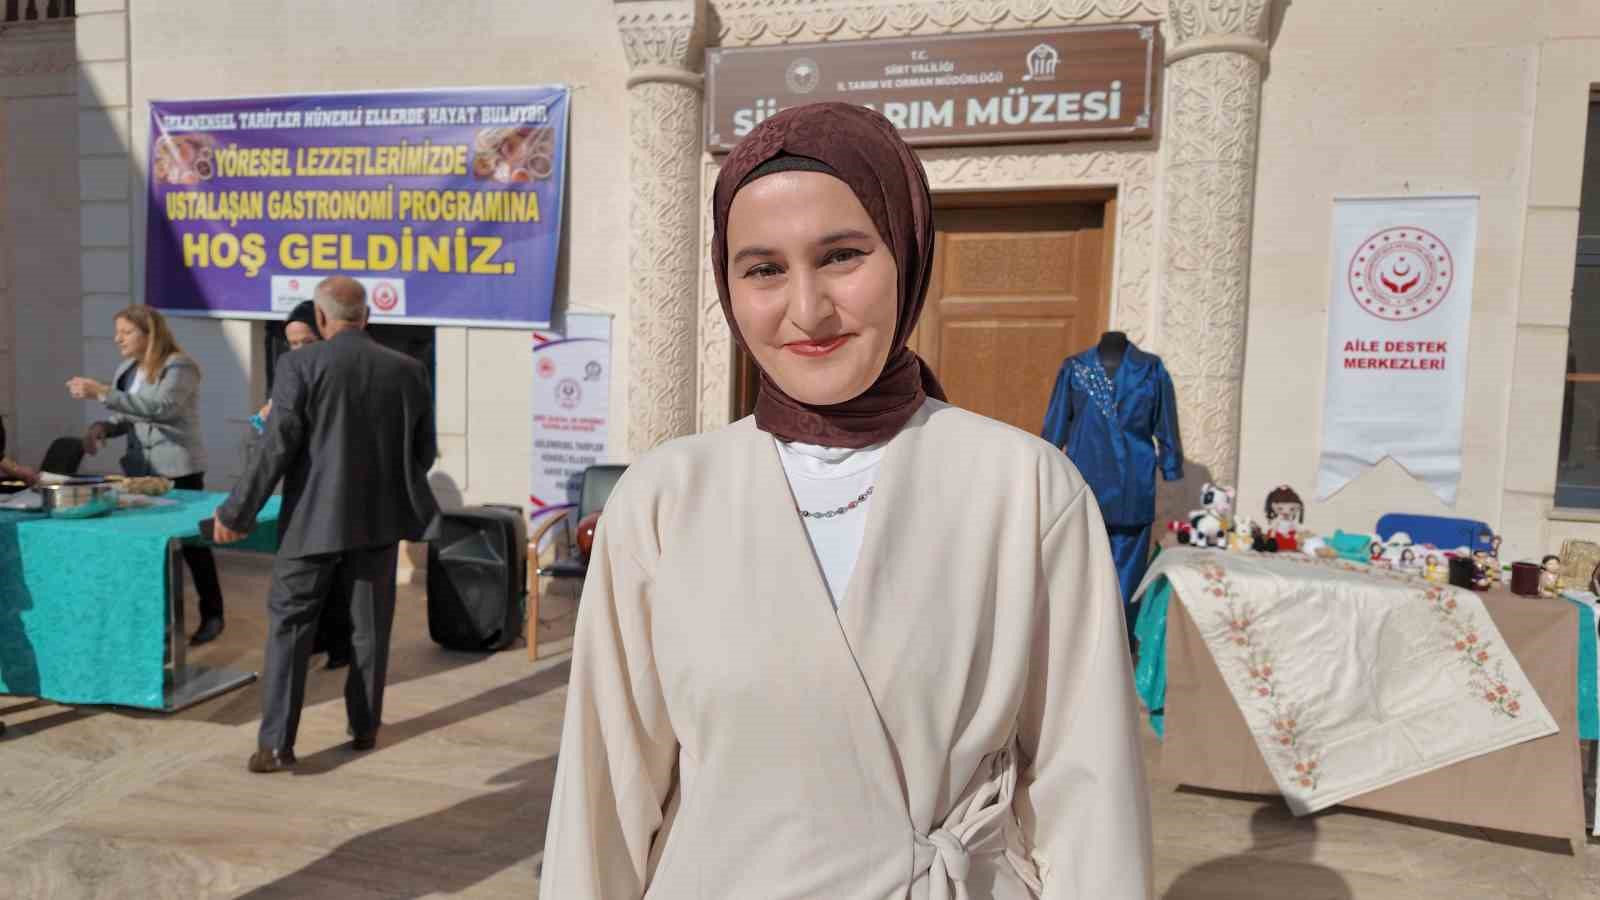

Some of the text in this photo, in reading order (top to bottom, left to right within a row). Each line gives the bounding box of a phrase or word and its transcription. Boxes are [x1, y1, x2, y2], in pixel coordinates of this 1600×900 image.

[881, 78, 894, 89] VE
[429, 106, 478, 124] HAYAT
[966, 80, 1122, 127] MÜZESİ
[214, 138, 468, 177] YÖRESEL LEZZETLERİMİZDE
[165, 183, 541, 227] USTALAŞAN GASTRONOMİ PROGRAMINA
[183, 226, 516, 278] HOŞ GELDİNİZ.
[1343, 338, 1448, 353] AİLE DESTEK
[1343, 356, 1446, 370] MERKEZLERİ
